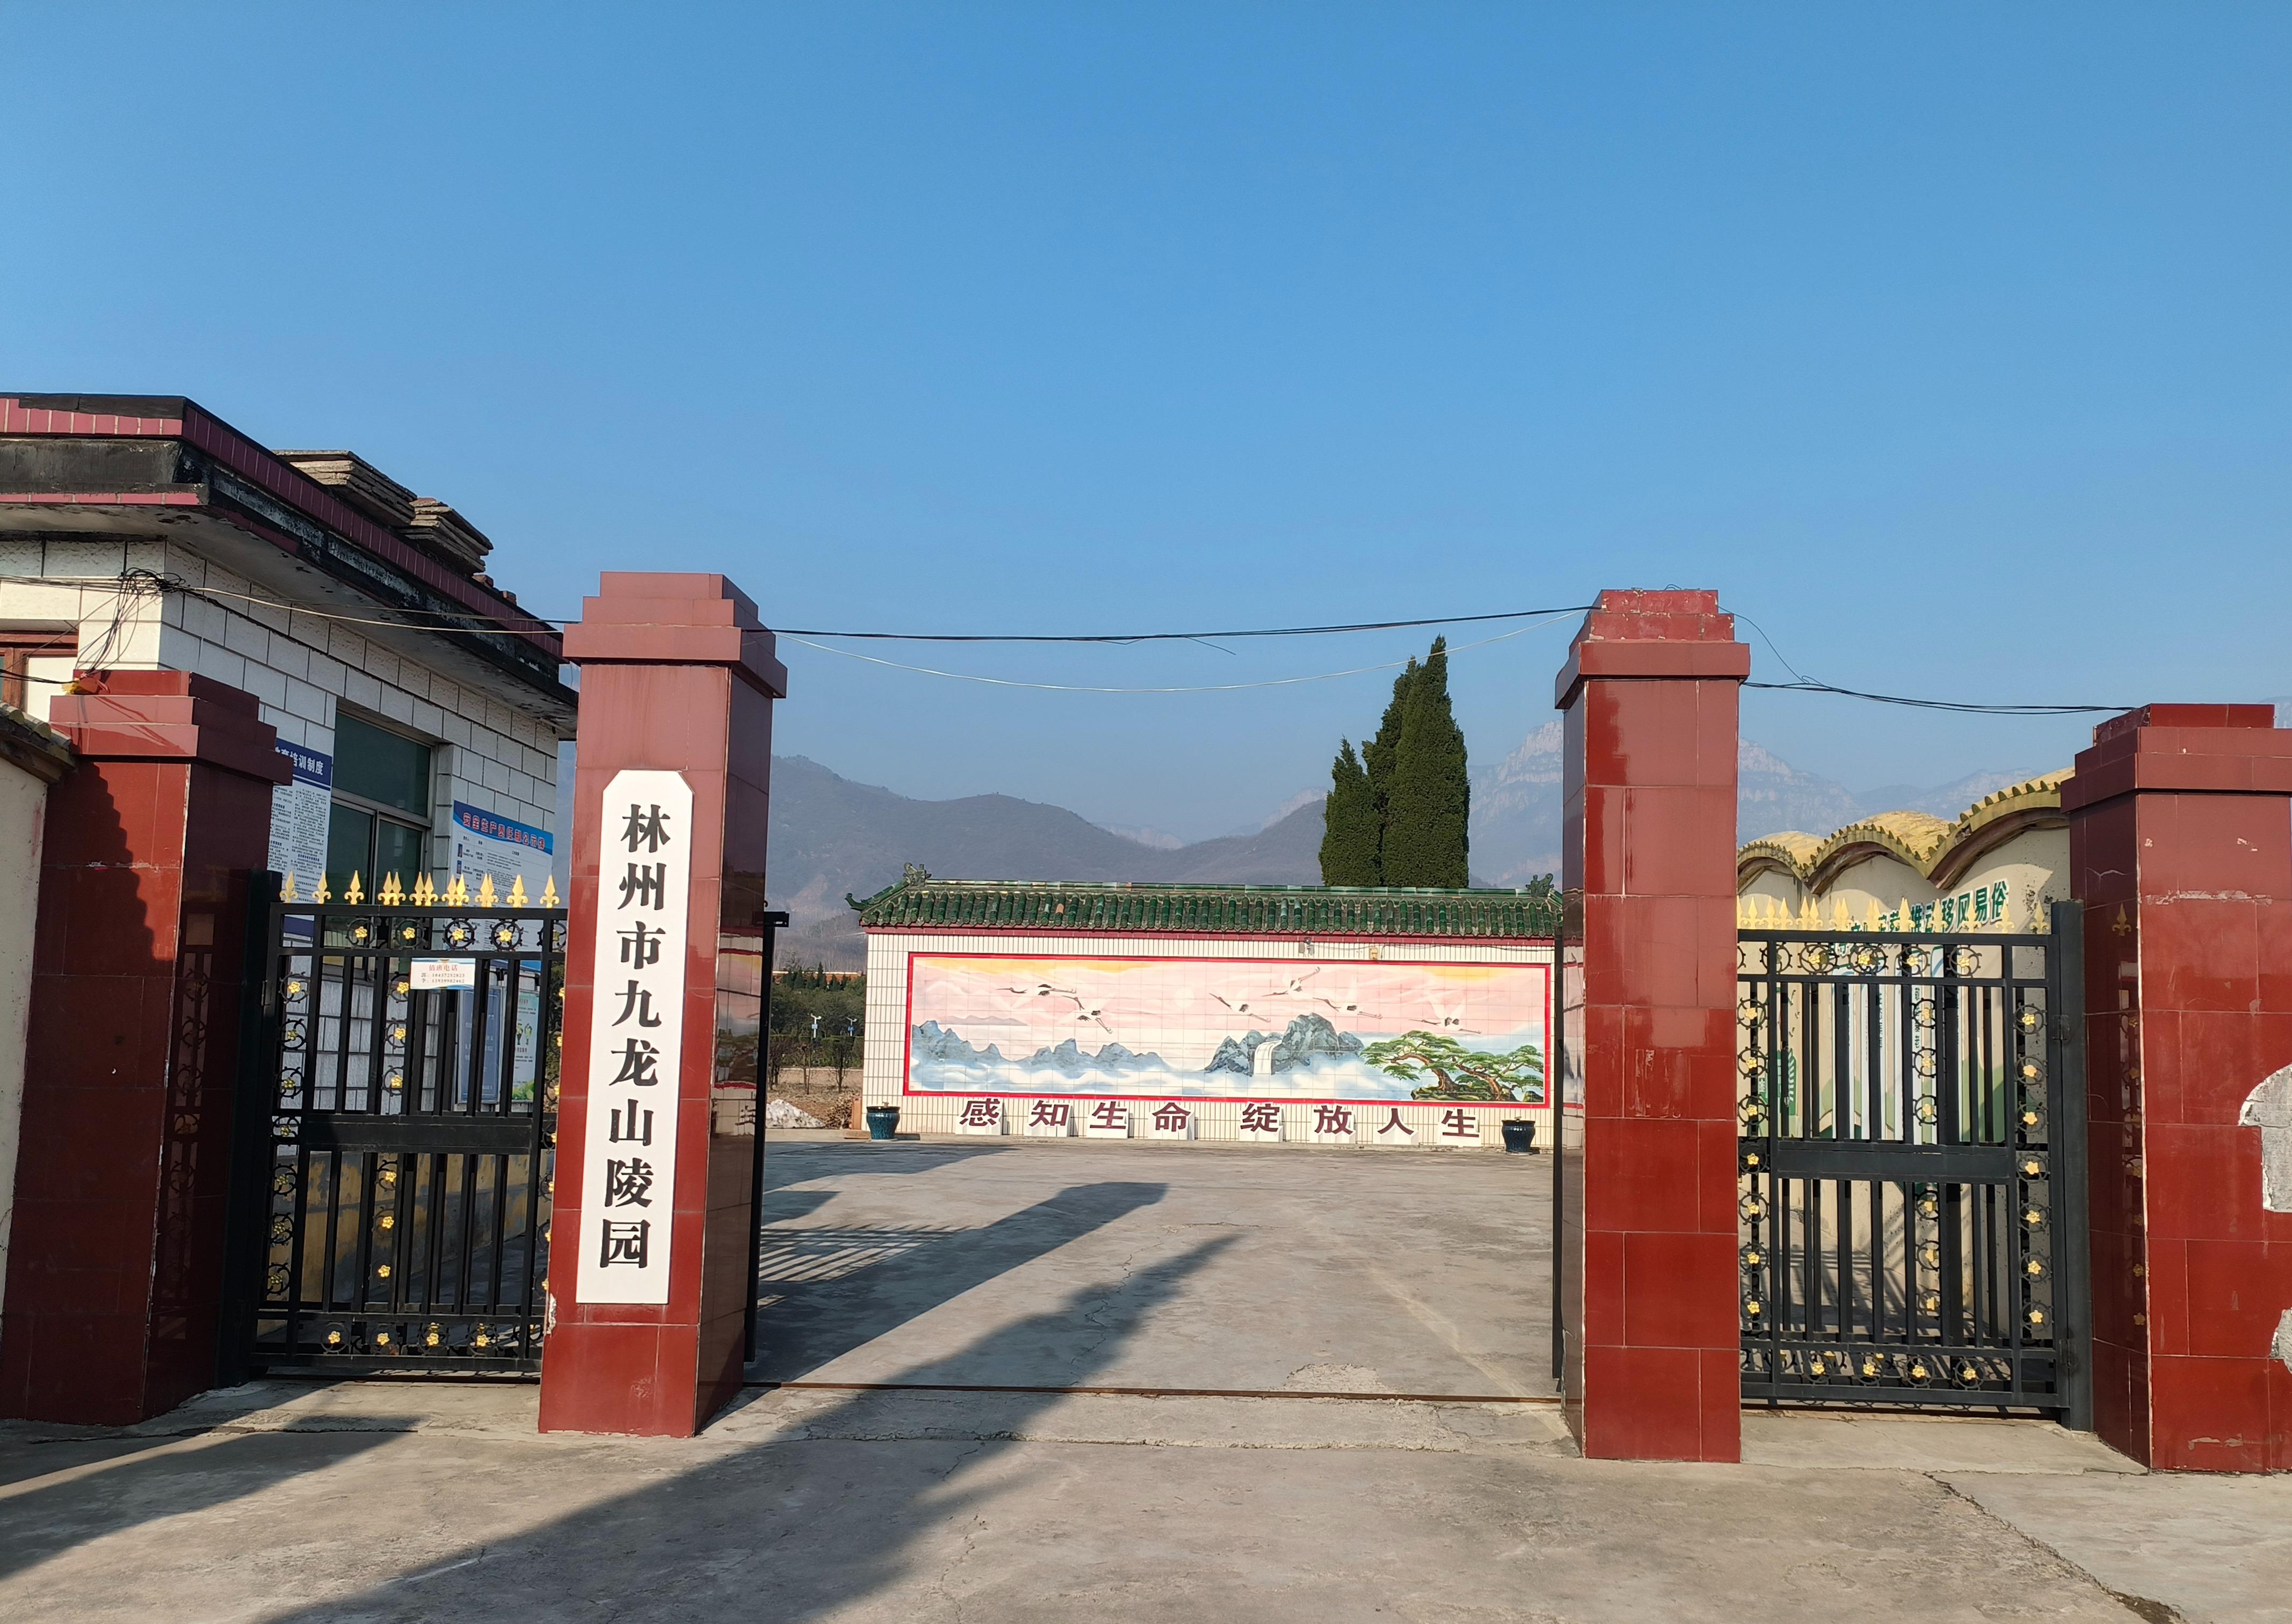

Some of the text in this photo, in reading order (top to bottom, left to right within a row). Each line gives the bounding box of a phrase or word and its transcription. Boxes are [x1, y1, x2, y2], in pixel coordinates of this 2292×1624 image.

[275, 747, 323, 775] 培训制度
[463, 812, 545, 850] 安全生产责任制公示牌
[600, 804, 670, 1268] 林州市九龙山陵园
